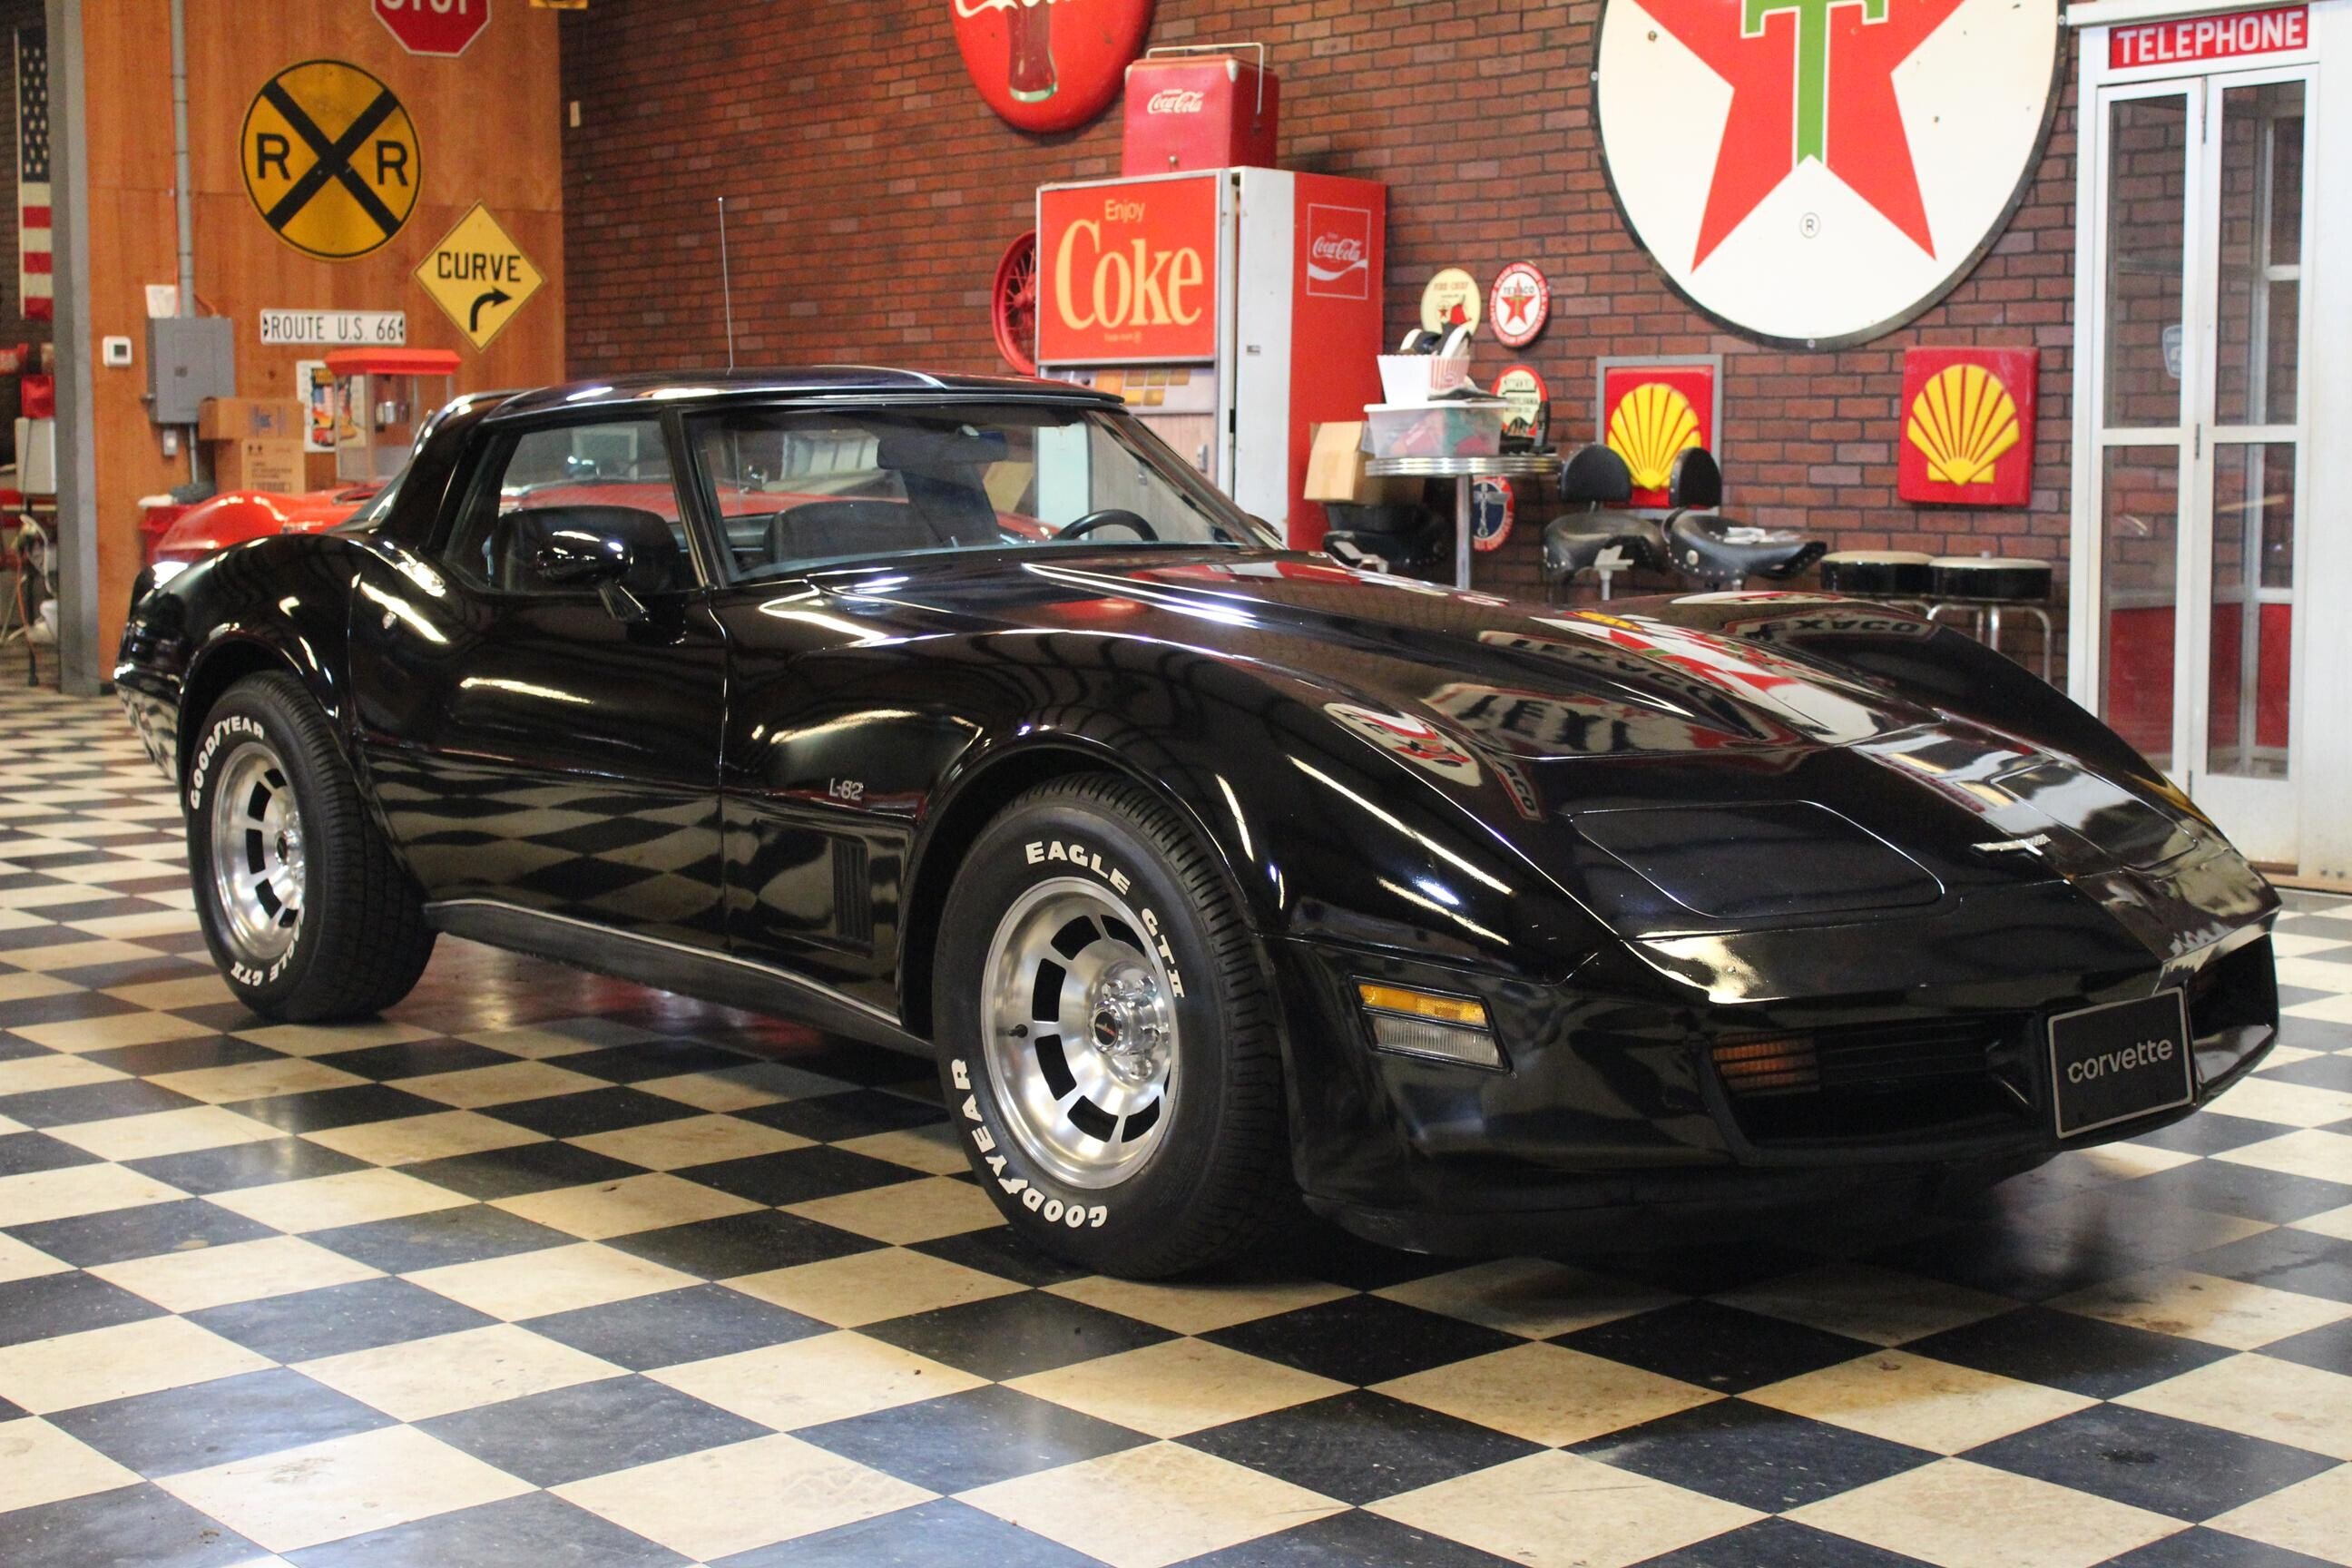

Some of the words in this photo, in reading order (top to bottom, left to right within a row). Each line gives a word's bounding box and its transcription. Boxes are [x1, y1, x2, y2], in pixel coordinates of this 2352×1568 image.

[2116, 10, 2305, 64] TELEPHONE
[1147, 92, 1205, 114] Coca-Cola
[257, 132, 290, 181] R
[377, 140, 408, 187] R
[1104, 199, 1145, 223] Enjoy
[437, 251, 522, 282] CURVE
[1312, 236, 1361, 262] Coca-Cola
[1055, 219, 1203, 330] Coke
[271, 316, 325, 340] ROUTE
[338, 317, 368, 340] U.S.
[377, 318, 397, 340] 66
[190, 715, 264, 810] GOODYEAR
[828, 777, 864, 801] L-82
[1024, 840, 1132, 897] EAGLE
[2066, 1038, 2174, 1083] corvette
[951, 1058, 1108, 1229] GOODYEAR
